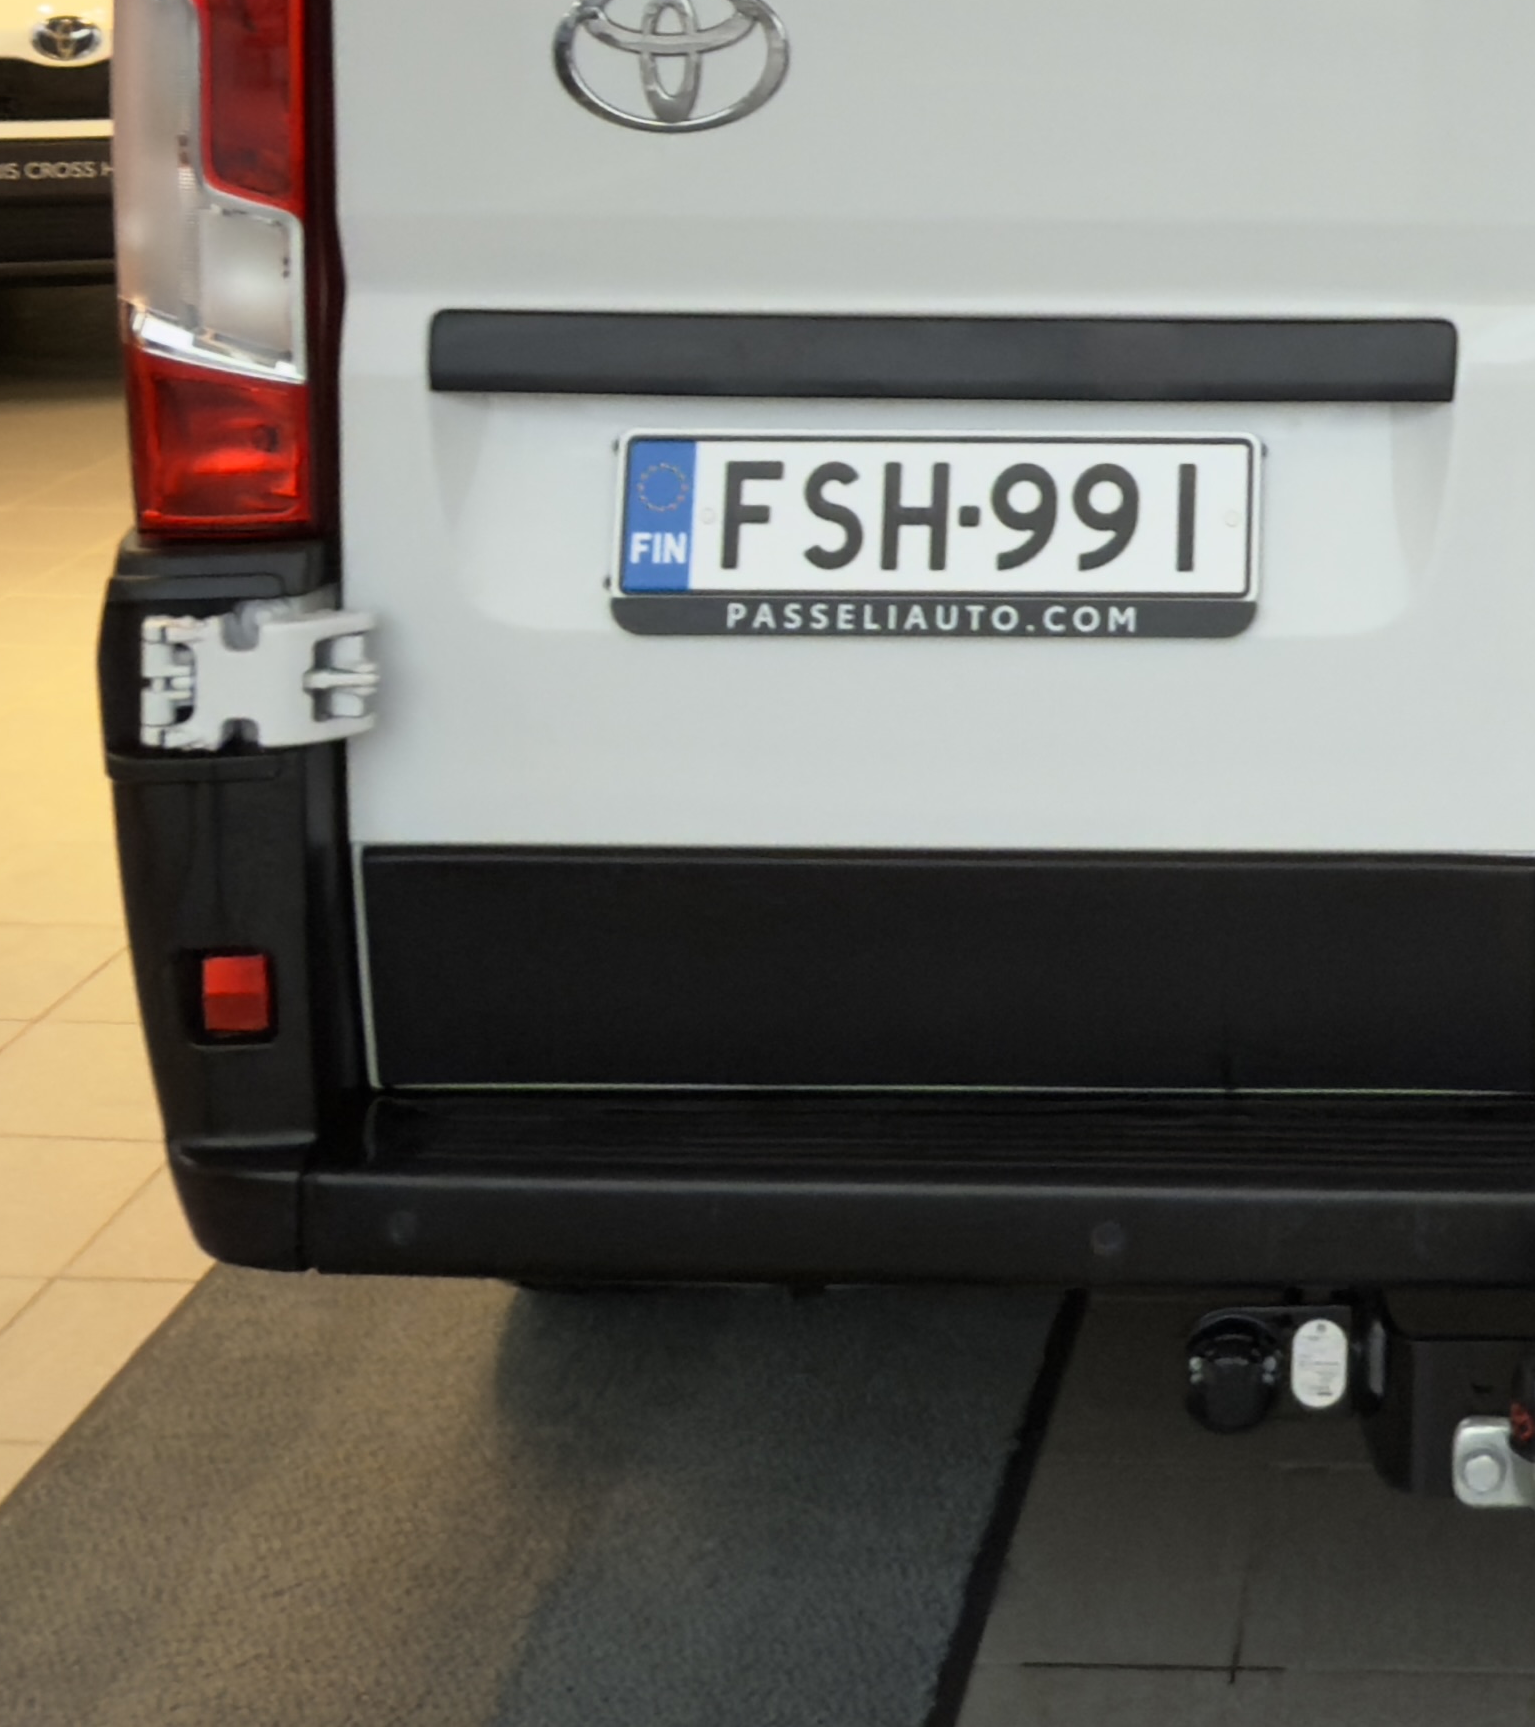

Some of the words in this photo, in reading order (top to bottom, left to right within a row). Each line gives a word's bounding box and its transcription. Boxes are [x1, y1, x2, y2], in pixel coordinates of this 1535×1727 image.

[23, 161, 97, 180] CROSS
[721, 460, 1197, 573] FSH-991
[630, 532, 687, 564] FIN
[725, 602, 1138, 633] PASSELIAUTO.COM
